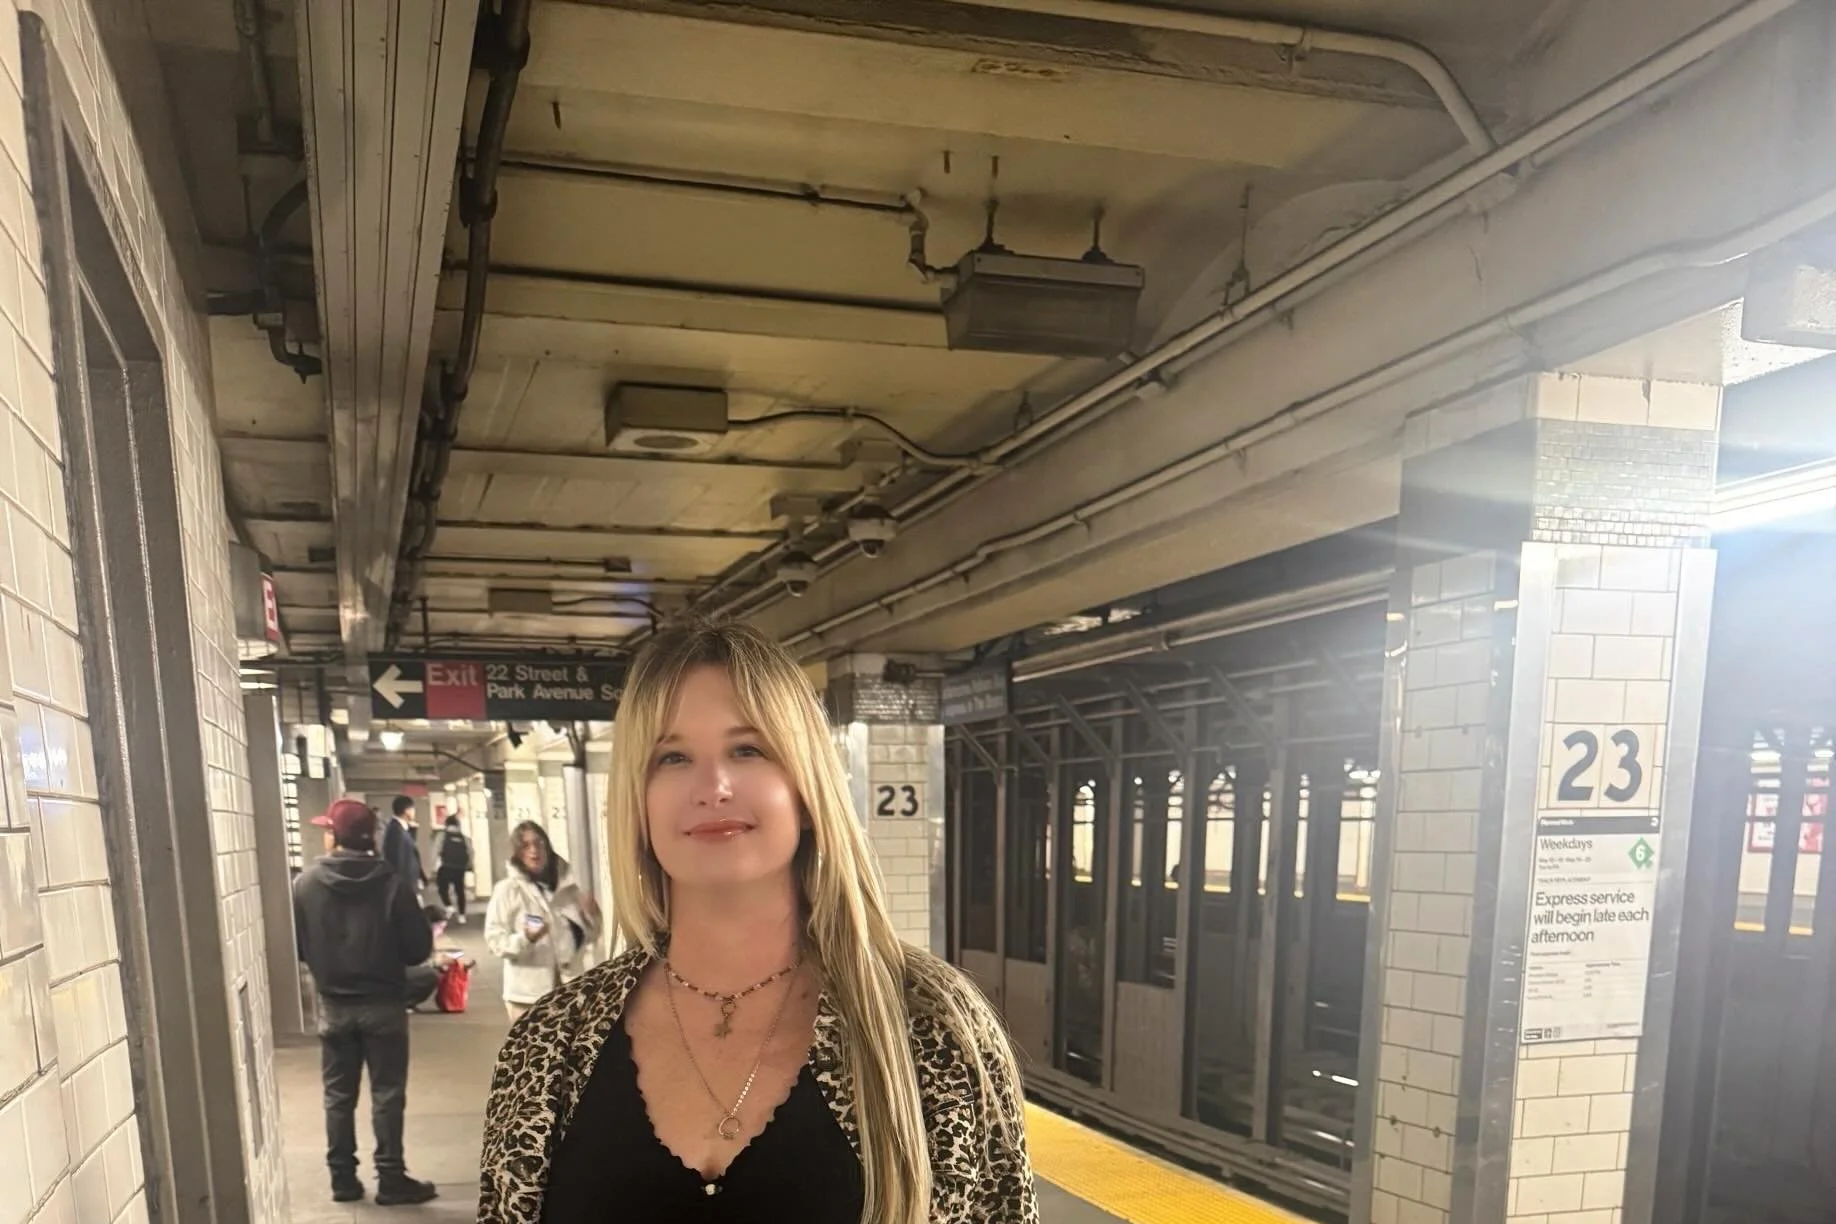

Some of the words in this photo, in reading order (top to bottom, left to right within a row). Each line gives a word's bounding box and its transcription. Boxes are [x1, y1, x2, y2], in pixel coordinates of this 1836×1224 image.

[426, 662, 479, 686] Exit
[486, 664, 510, 681] 22
[516, 664, 569, 682] Street
[576, 665, 589, 682] &
[487, 683, 526, 700] Park
[533, 683, 595, 700] Avenue
[1557, 729, 1643, 803] 23
[877, 785, 919, 817] 23
[1540, 838, 1593, 851] Weekdays
[1635, 844, 1646, 862] 6
[1535, 891, 1588, 908] Express
[1589, 889, 1635, 904] service
[1533, 910, 1554, 926] will
[1556, 908, 1592, 926] begin
[1593, 907, 1617, 923] late
[1618, 907, 1649, 923] each
[1531, 929, 1594, 944] afternoon
